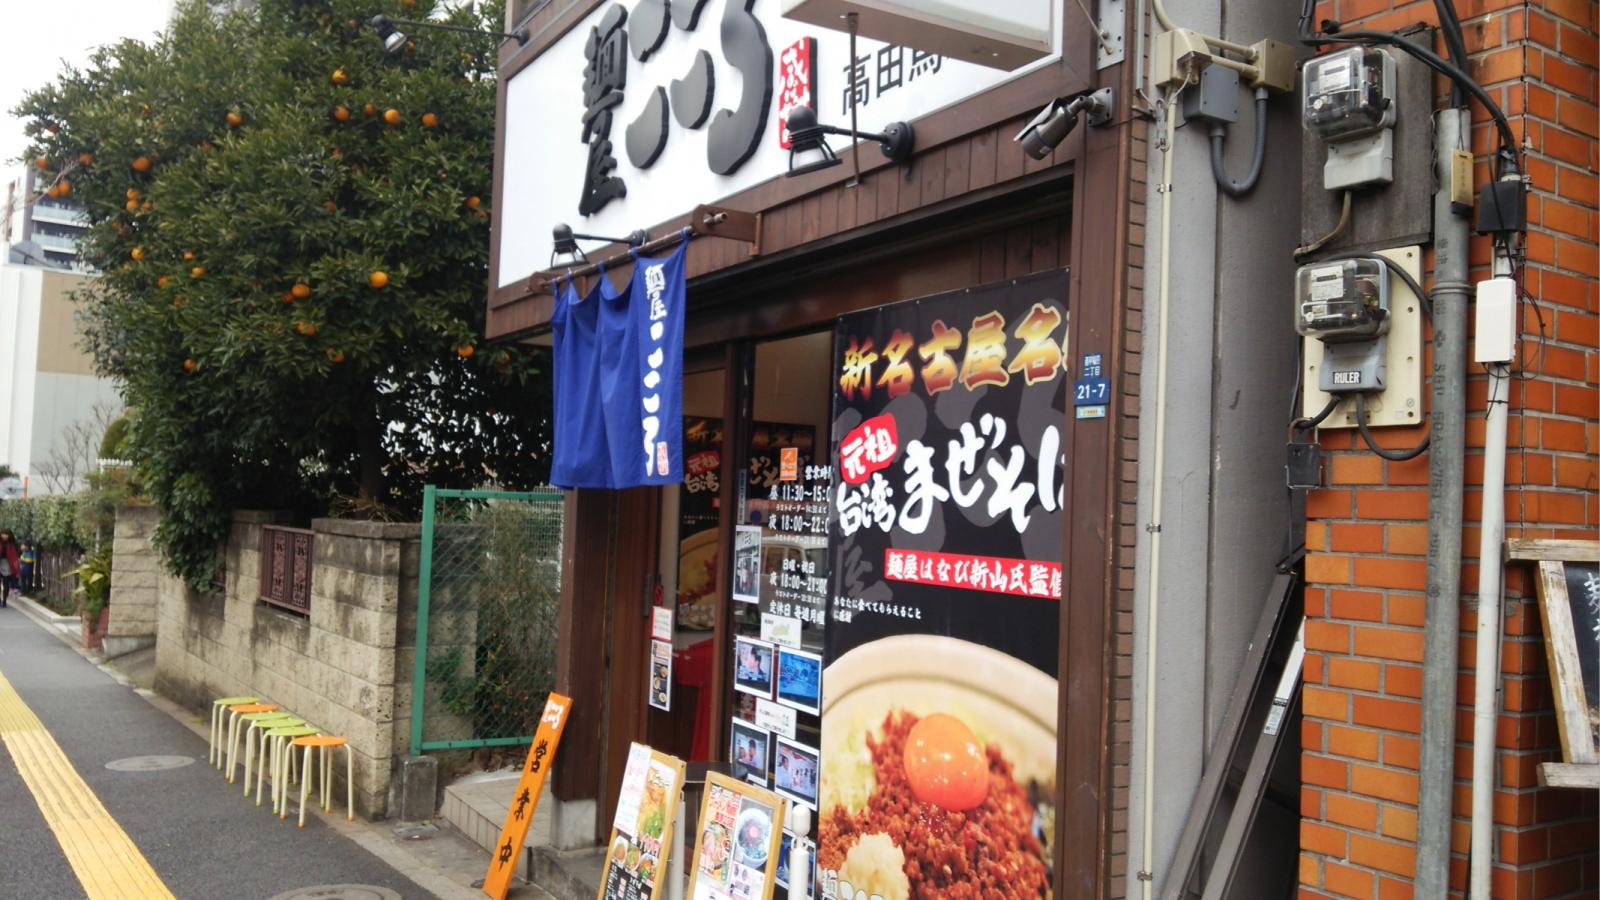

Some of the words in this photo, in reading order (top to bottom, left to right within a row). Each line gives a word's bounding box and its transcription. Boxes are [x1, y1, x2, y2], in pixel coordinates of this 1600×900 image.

[838, 303, 1069, 401] 新名古屋名
[1334, 371, 1361, 384] RULER
[1077, 383, 1105, 399] 21-7
[841, 426, 896, 479] 元祖
[835, 473, 896, 536] 台湾
[498, 739, 548, 872] 営業中
